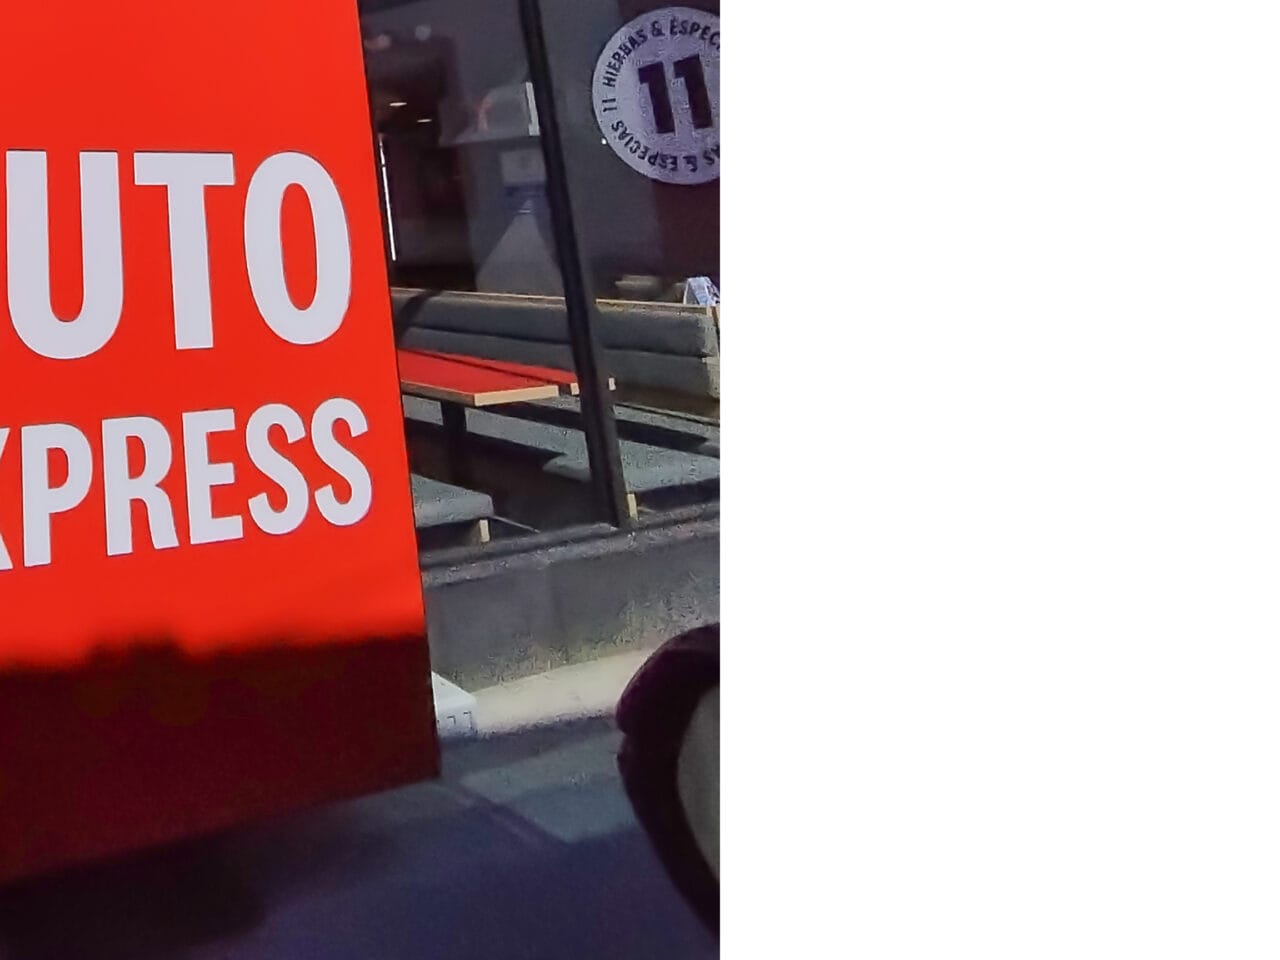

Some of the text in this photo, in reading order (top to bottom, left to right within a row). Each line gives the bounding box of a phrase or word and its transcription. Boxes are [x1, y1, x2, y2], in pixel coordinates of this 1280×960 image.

[651, 20, 666, 37] &
[670, 19, 720, 49] ESPEC
[637, 53, 713, 134] 11
[611, 120, 678, 171] ESPECIAS
